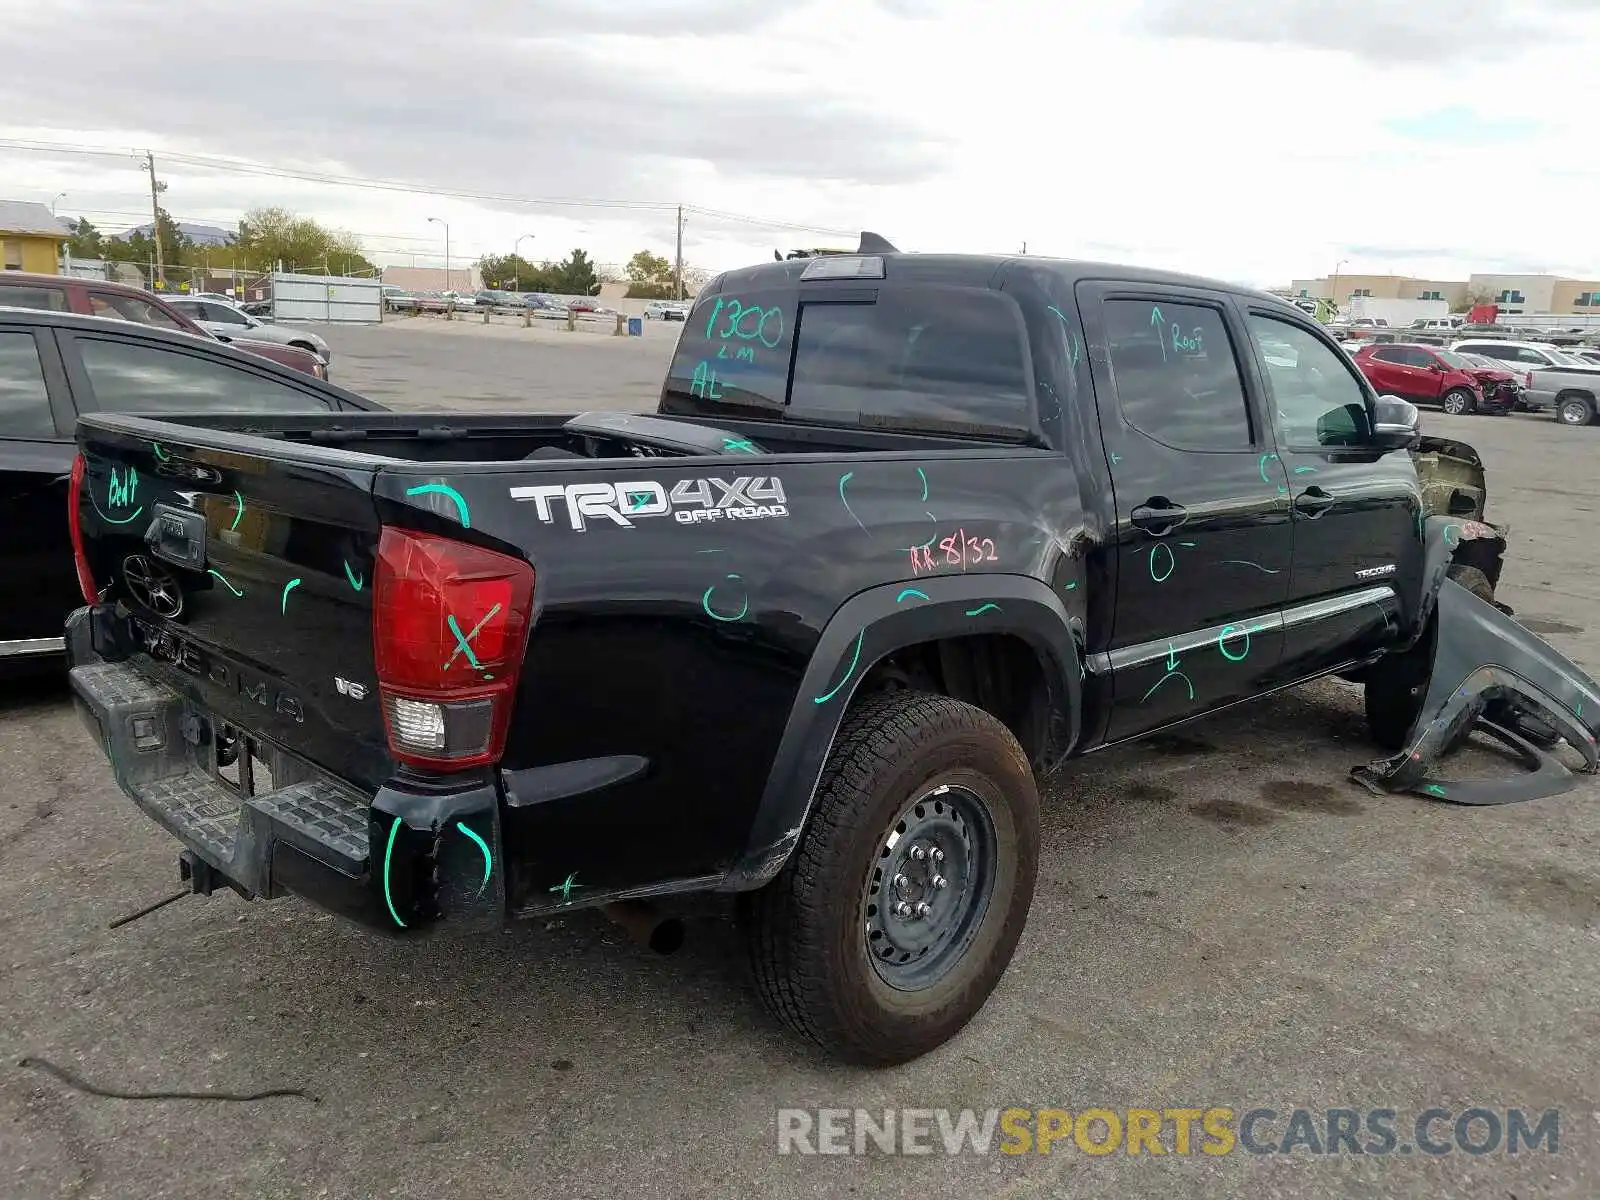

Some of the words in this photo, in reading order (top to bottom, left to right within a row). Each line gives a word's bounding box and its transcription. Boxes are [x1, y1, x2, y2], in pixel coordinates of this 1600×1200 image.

[706, 298, 783, 348] 1300
[509, 481, 672, 532] TRD
[670, 476, 787, 508] 4X4
[674, 507, 723, 524] OFF
[726, 503, 790, 521] ROAD
[939, 528, 999, 572] 8/32
[334, 676, 366, 701] V6
